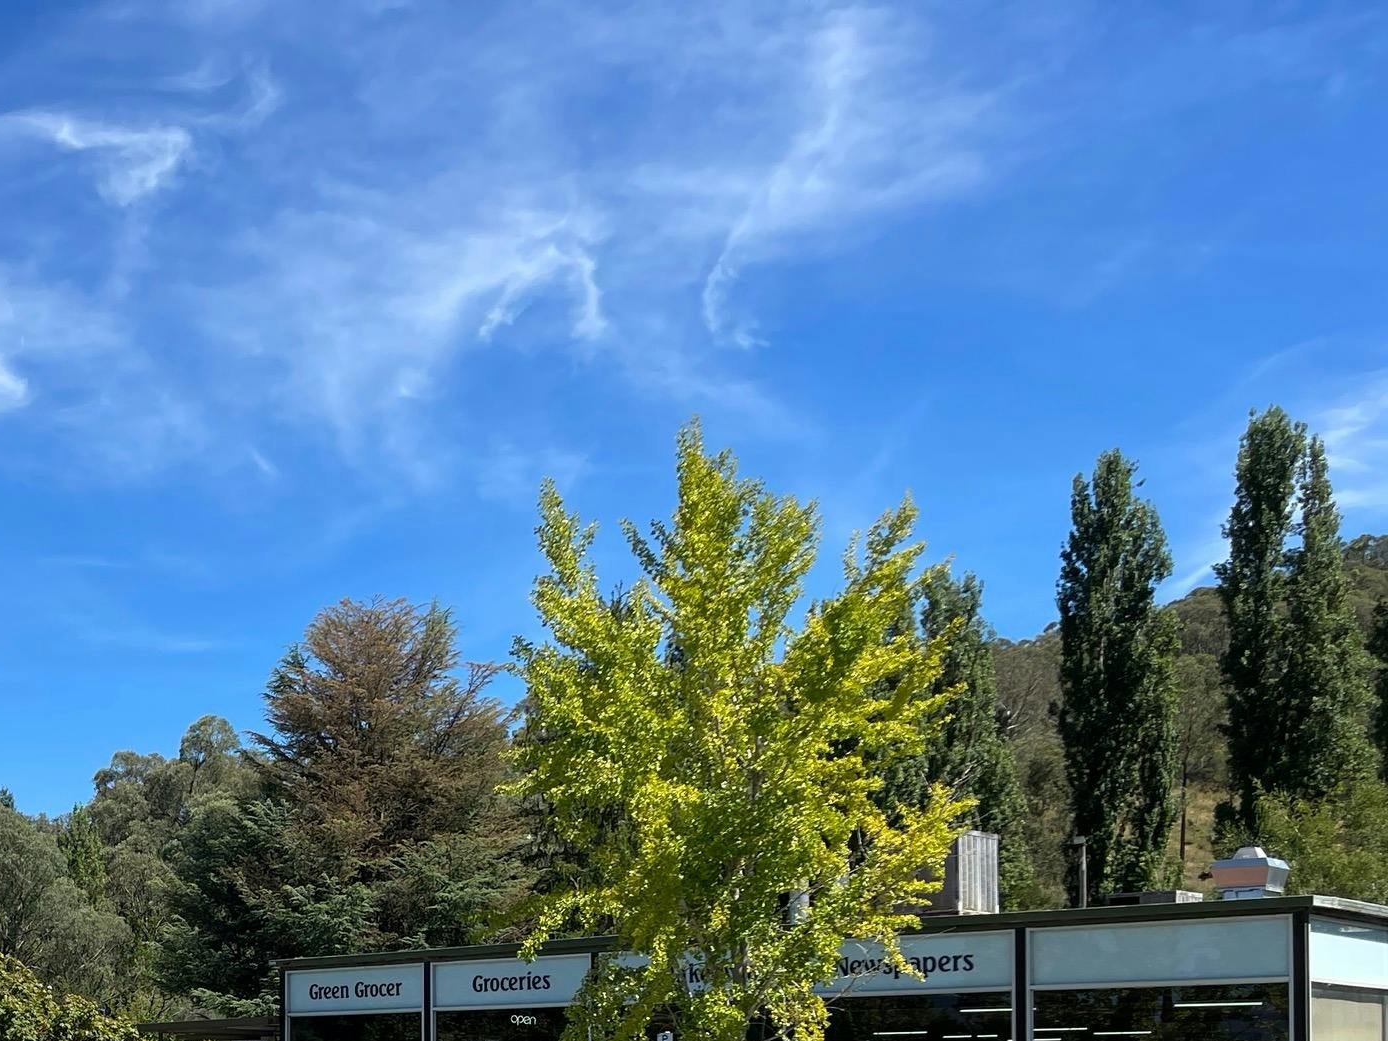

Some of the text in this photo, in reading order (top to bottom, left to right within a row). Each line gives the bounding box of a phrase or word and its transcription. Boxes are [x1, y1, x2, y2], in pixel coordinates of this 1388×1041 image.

[309, 981, 402, 1000] Green Grocer
[472, 971, 551, 993] Groceries
[510, 1014, 536, 1026] open
